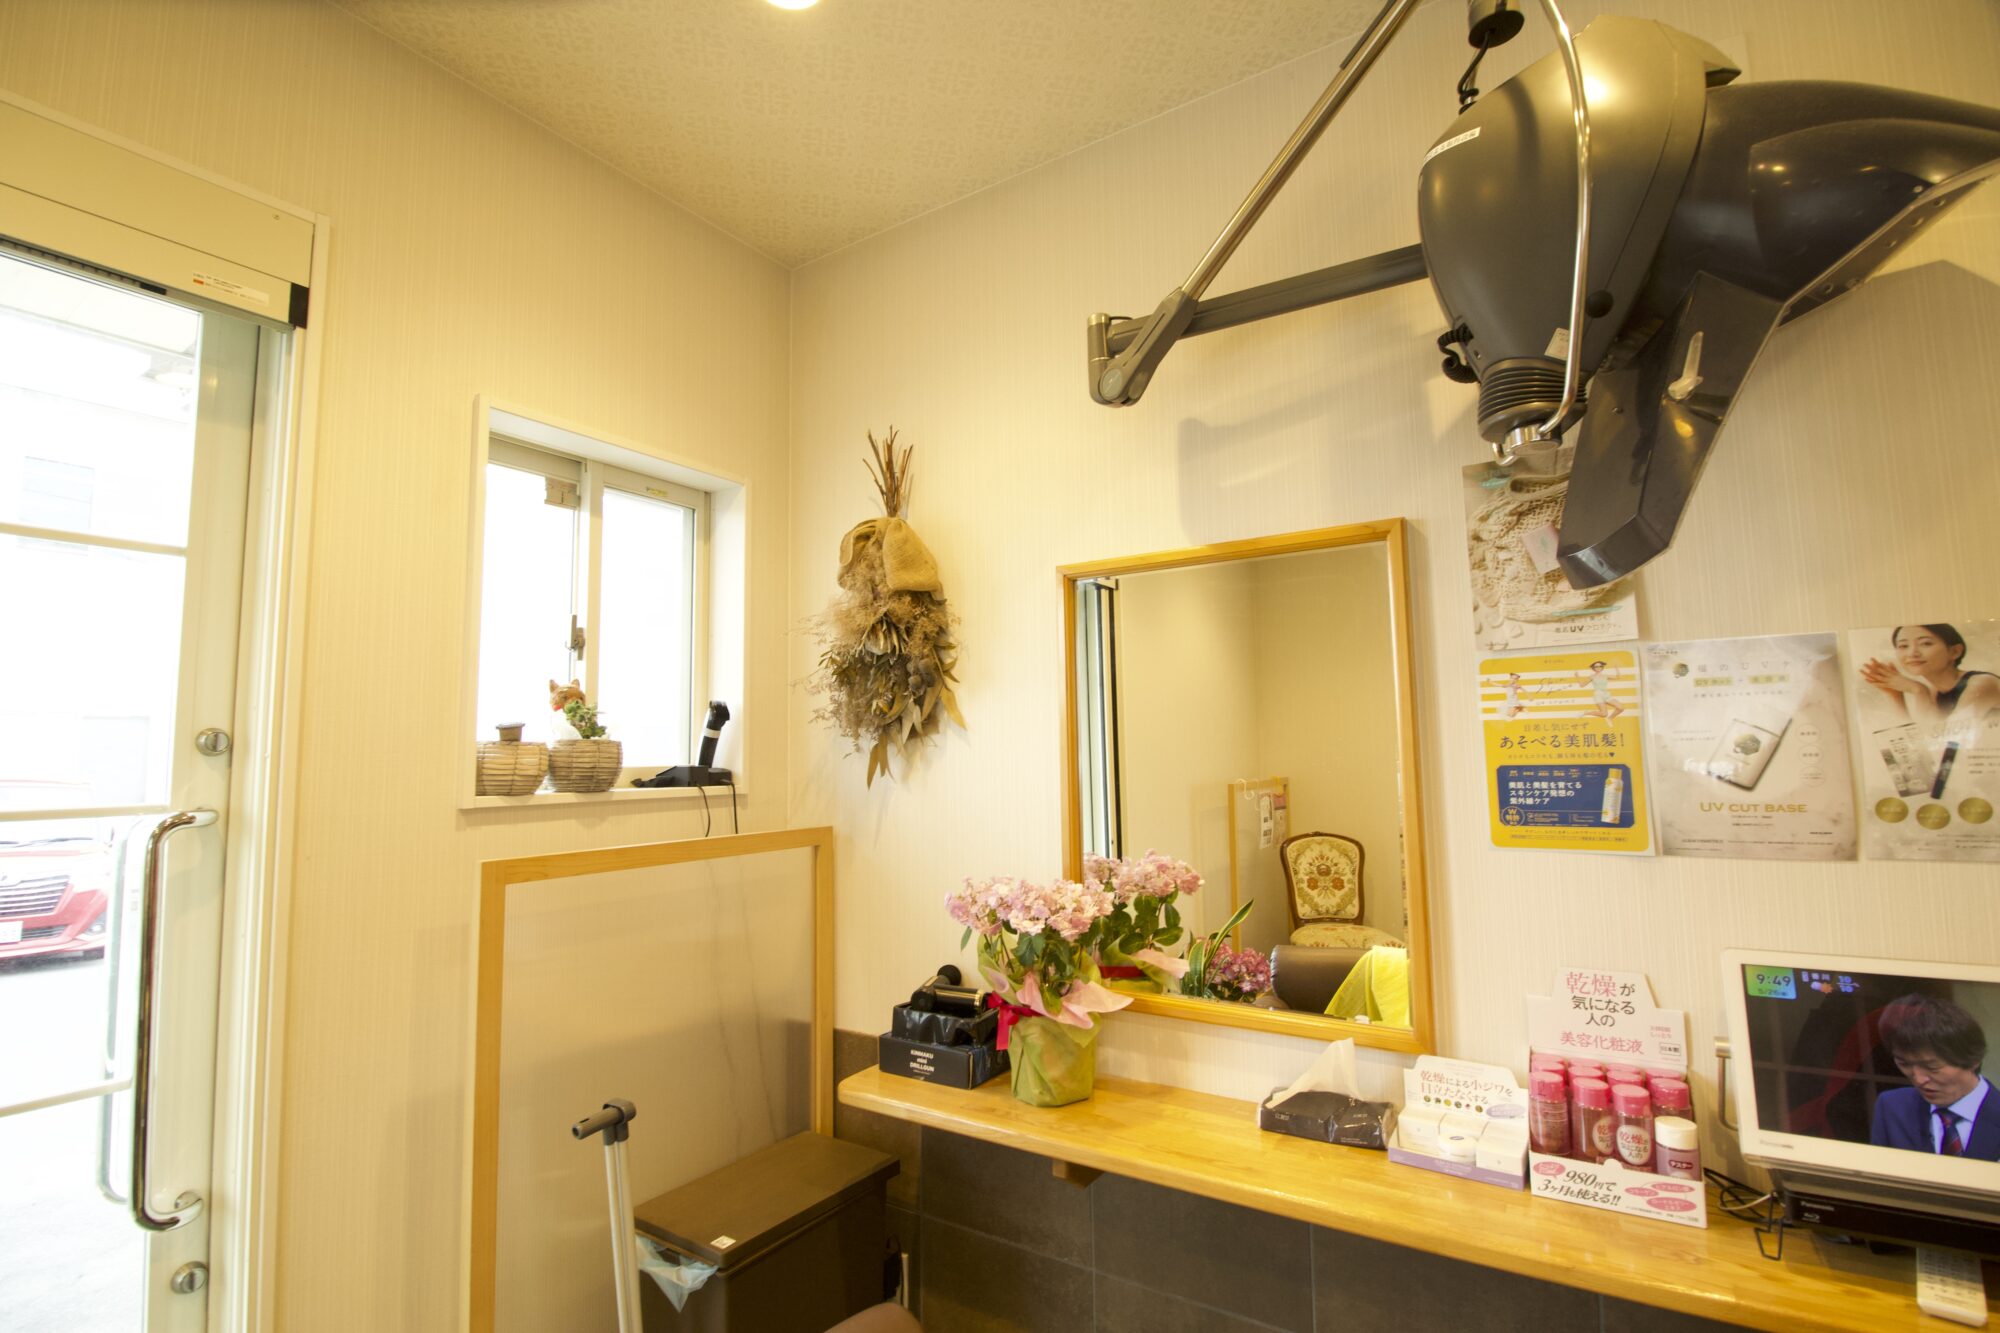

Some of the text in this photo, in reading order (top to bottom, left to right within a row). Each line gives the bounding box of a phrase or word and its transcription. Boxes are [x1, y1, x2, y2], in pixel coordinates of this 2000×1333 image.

[1524, 722, 1589, 732] 日差し気にせず
[1500, 733, 1625, 750] あそべる美肌髪!
[1509, 789, 1575, 798] スキンケア発想の
[1700, 802, 1808, 814] UV CUT BASE
[1566, 971, 1636, 998] 乾燥が
[1756, 973, 1792, 987] 9:49
[1571, 995, 1636, 1015] 気になる
[1586, 1012, 1616, 1027] 人の
[1560, 1030, 1645, 1056] 美容化粧液
[1670, 1160, 1693, 1169] テスター
[1564, 1169, 1618, 1192] 980円で
